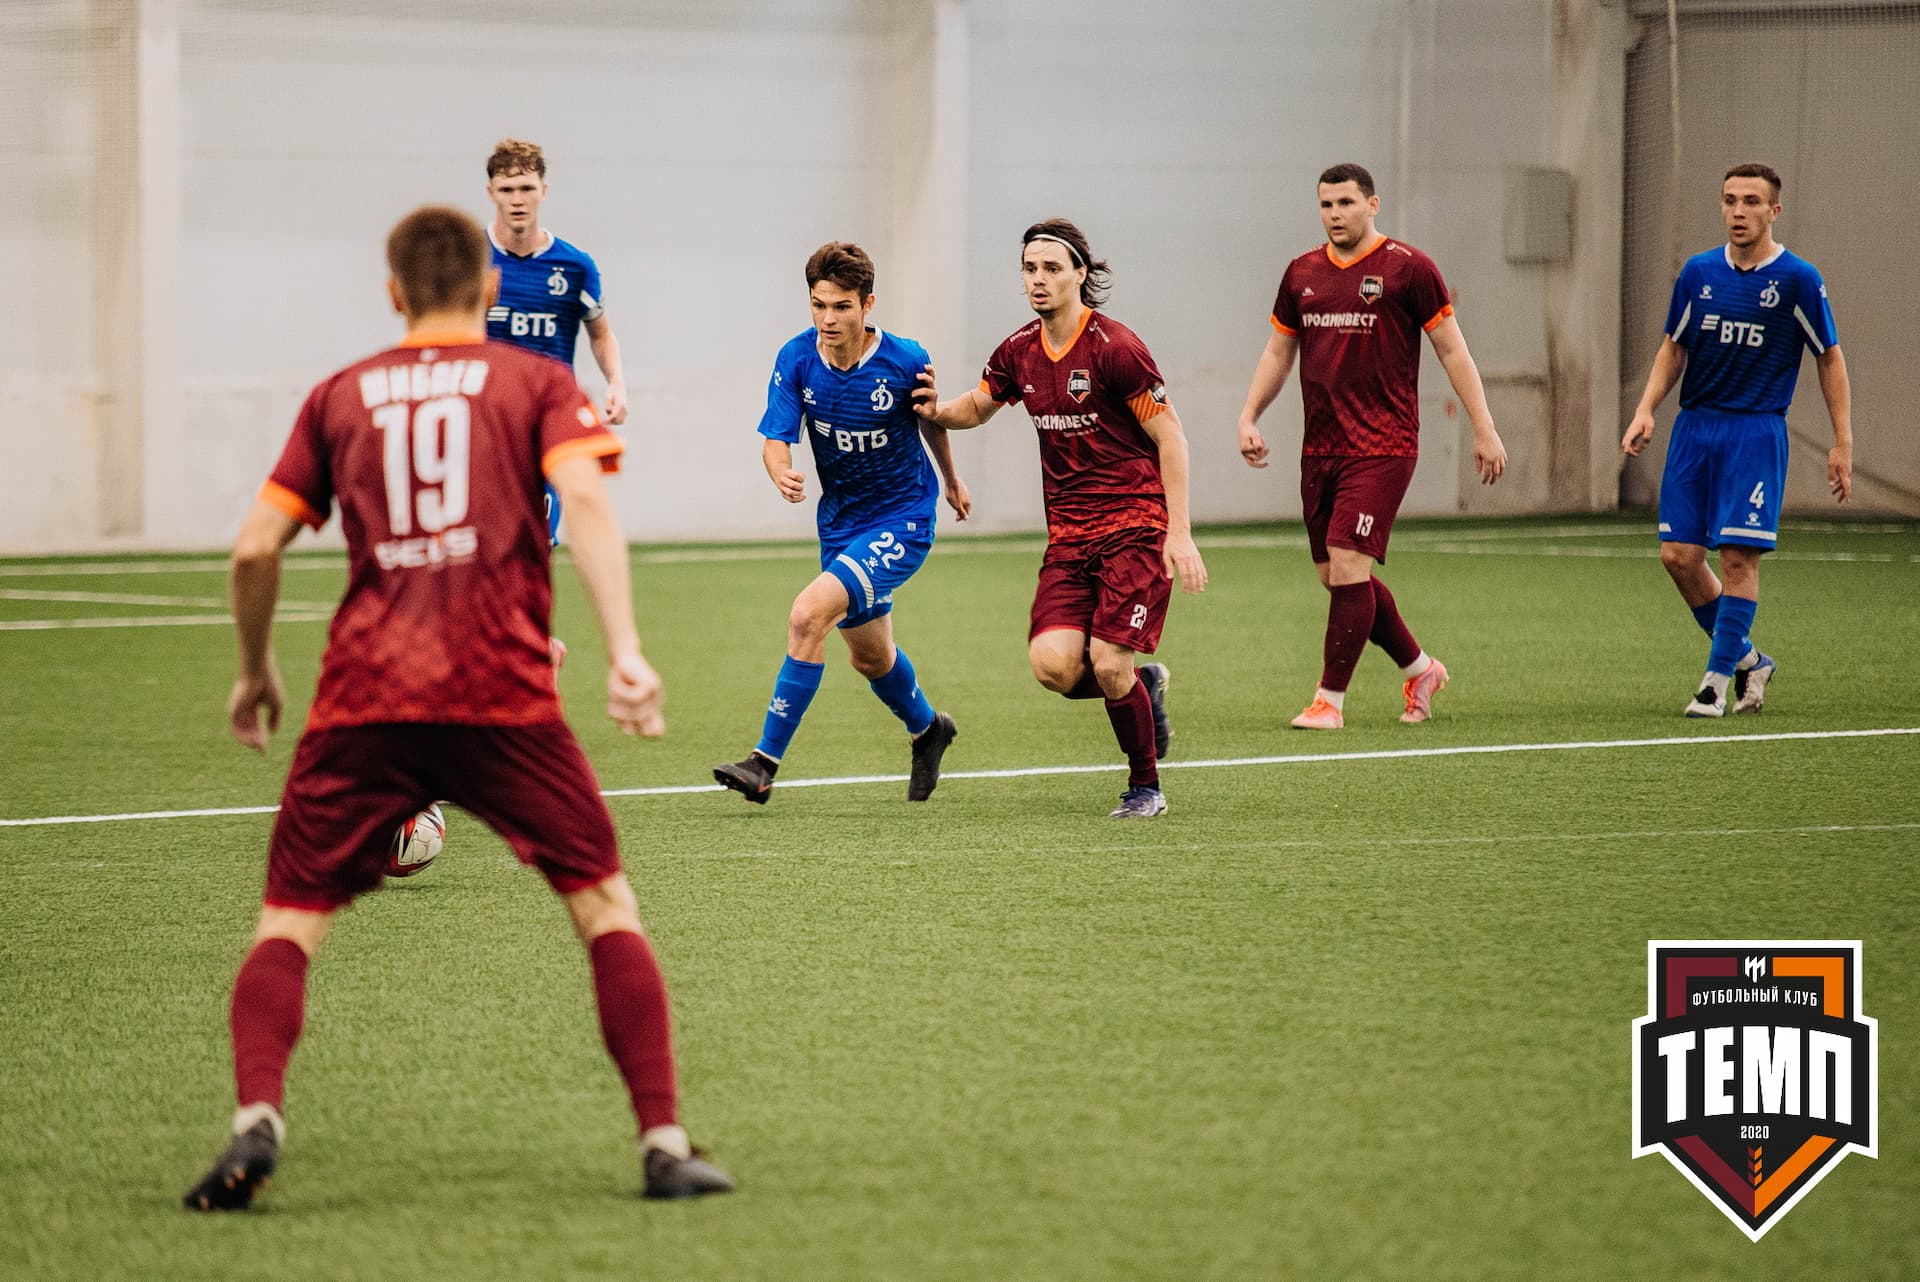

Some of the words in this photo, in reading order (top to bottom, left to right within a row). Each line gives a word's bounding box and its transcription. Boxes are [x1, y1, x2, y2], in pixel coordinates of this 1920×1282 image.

[511, 312, 558, 337] ВТБ
[1720, 320, 1766, 347] ВТБ
[835, 428, 889, 452] ВТБ
[372, 395, 471, 536] 19
[1749, 481, 1764, 509] 4
[1356, 512, 1374, 537] 13
[868, 532, 906, 569] 22
